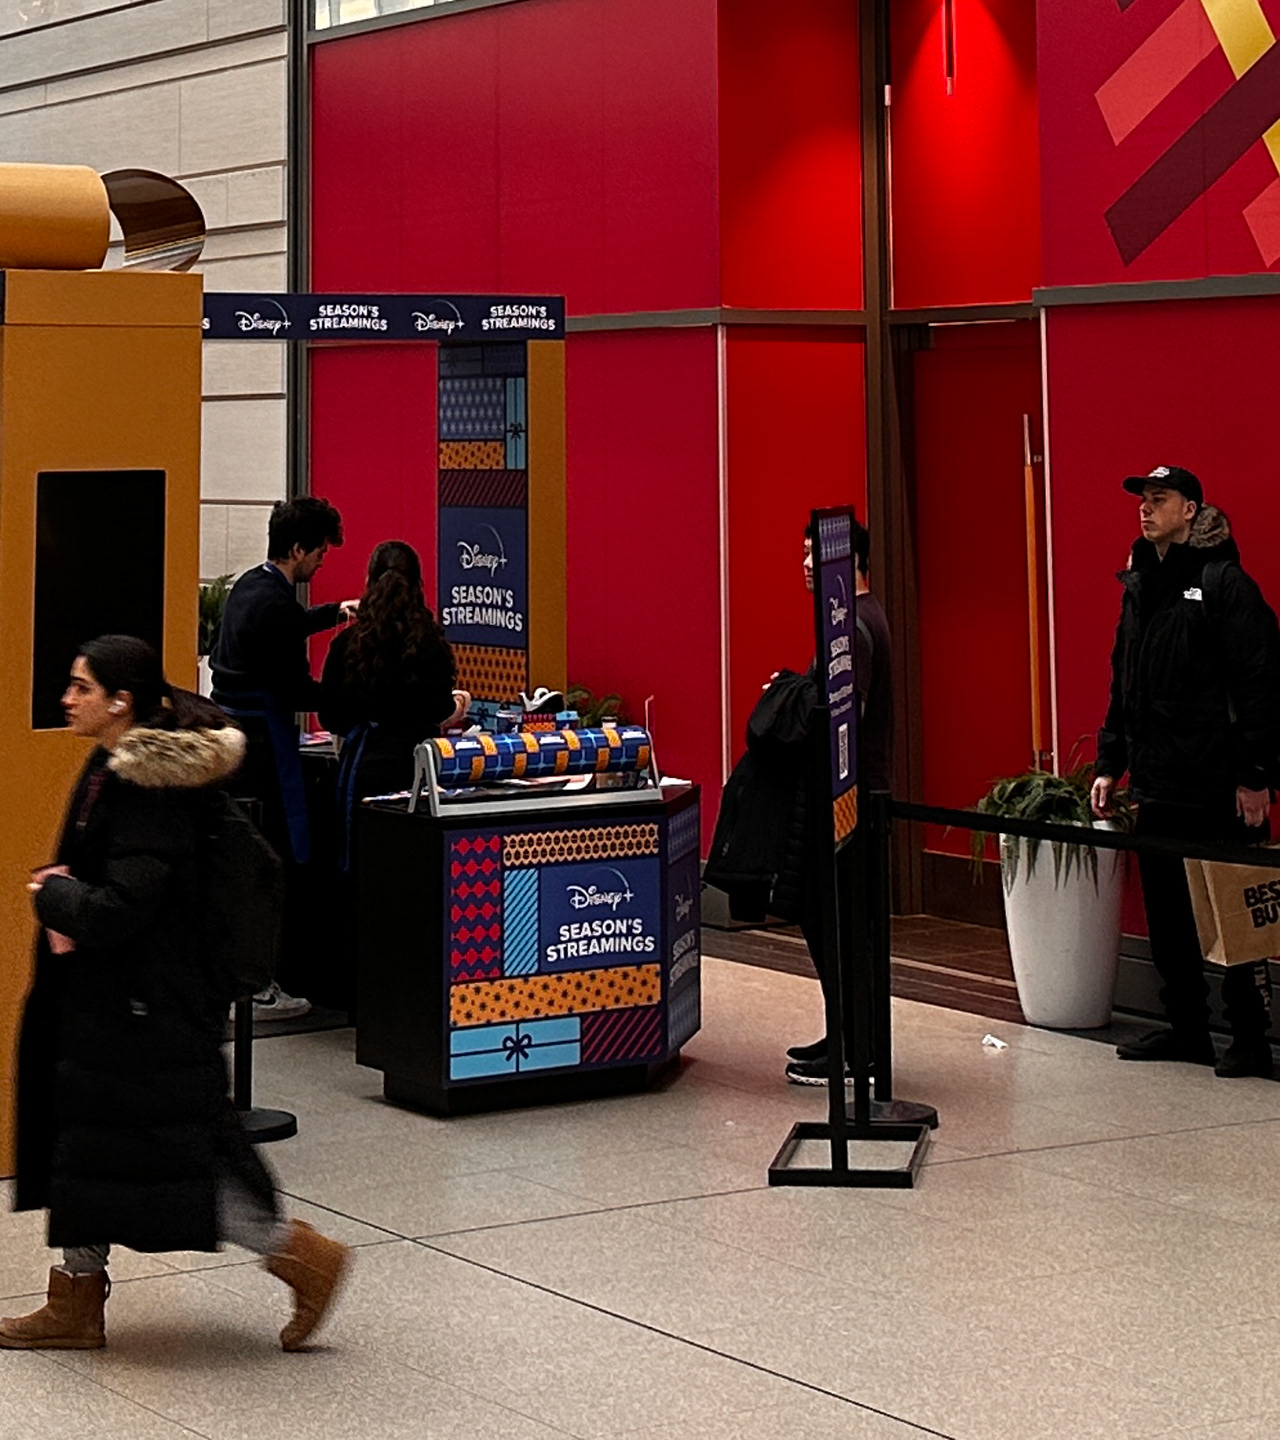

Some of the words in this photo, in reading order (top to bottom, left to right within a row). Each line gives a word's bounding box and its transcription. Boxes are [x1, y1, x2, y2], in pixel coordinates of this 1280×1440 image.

[318, 304, 380, 318] SEASON'S
[490, 305, 547, 318] SEASON'S
[235, 311, 291, 335] Disney+
[309, 317, 388, 331] STREAMINGS
[411, 312, 465, 335] Disney+
[481, 318, 556, 331] STREAMINGS
[457, 541, 508, 577] Disney+
[451, 585, 514, 608] SEASON'S
[442, 606, 523, 632] STREAMINGS
[566, 886, 634, 911] Disney+
[559, 918, 643, 942] SEASON'S
[546, 935, 655, 962] STREAMINGS
